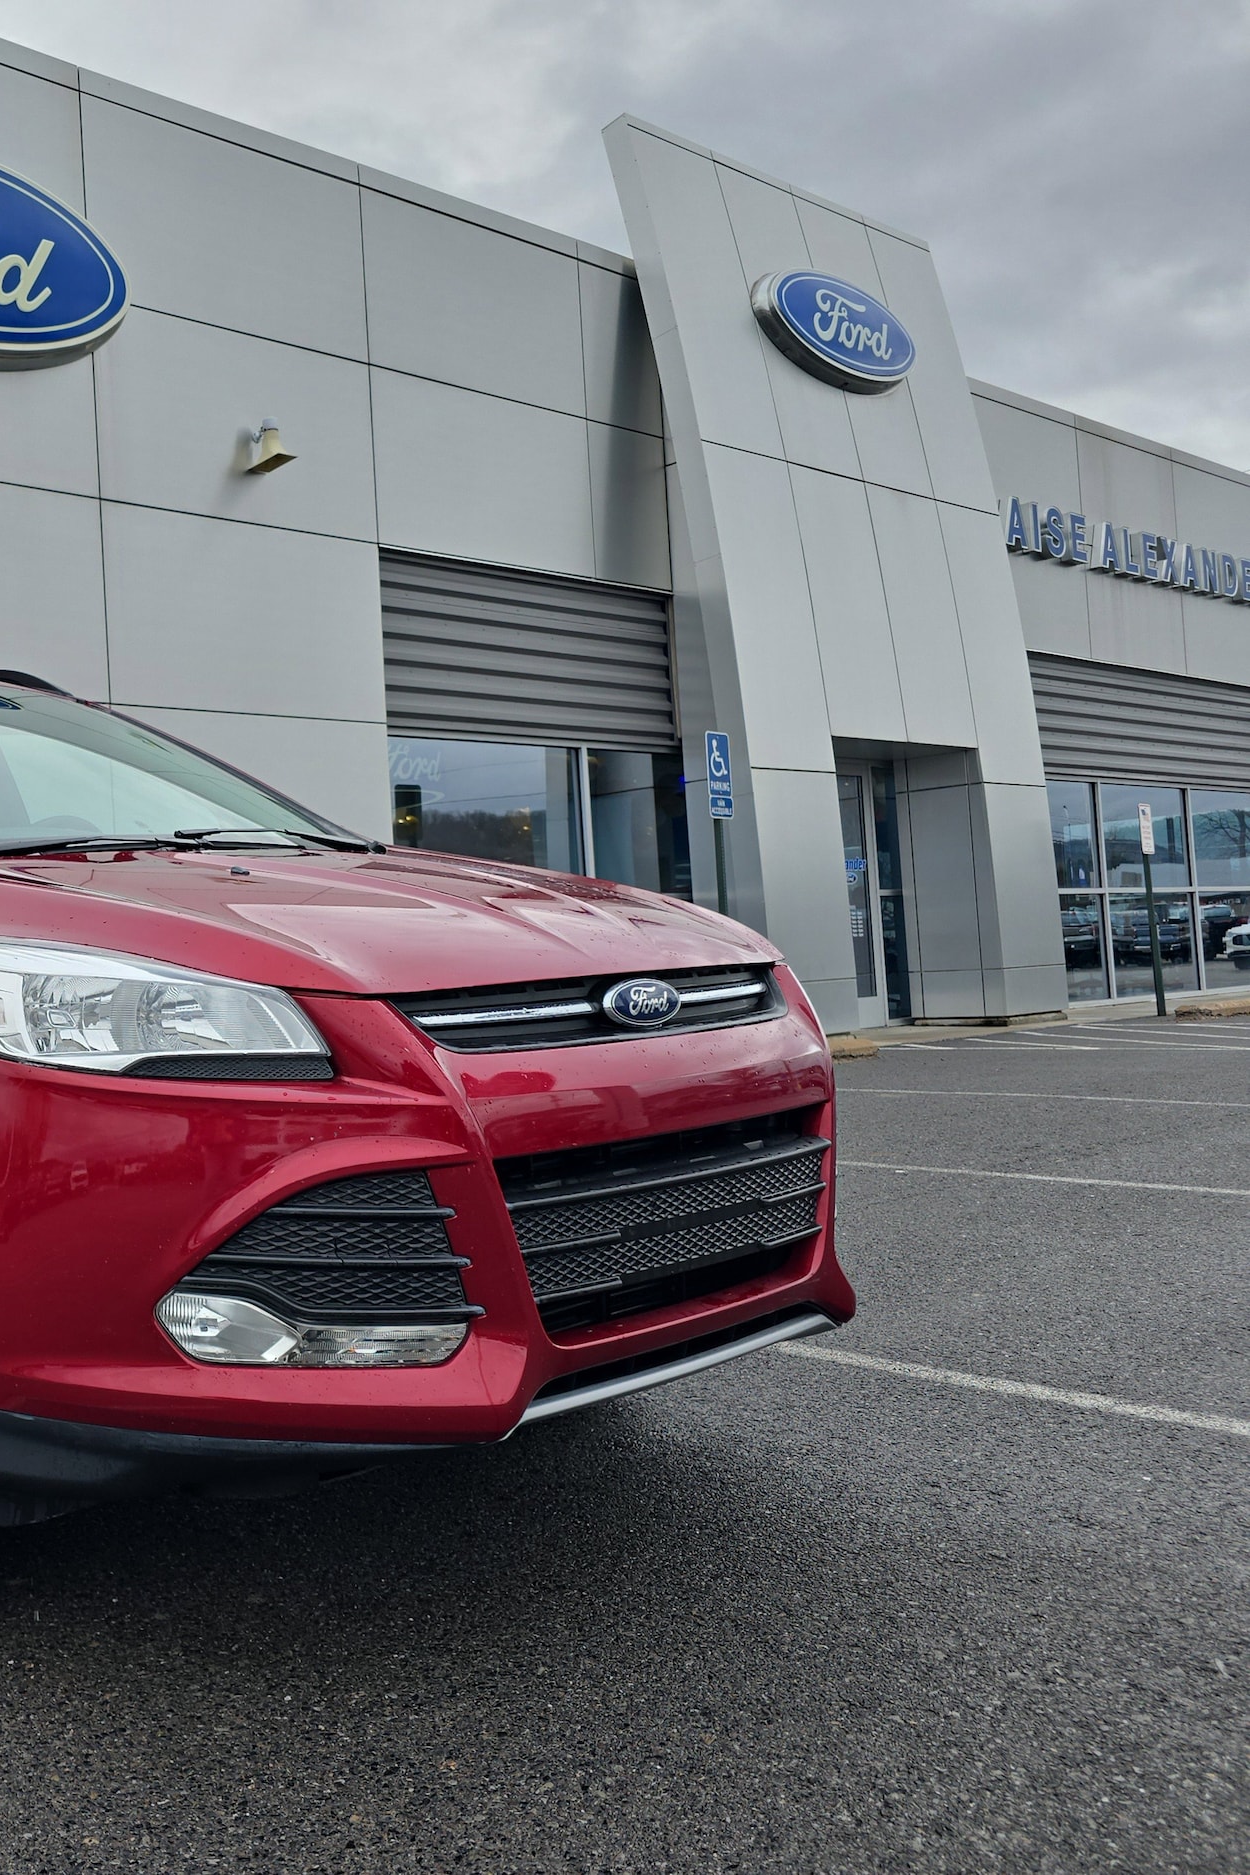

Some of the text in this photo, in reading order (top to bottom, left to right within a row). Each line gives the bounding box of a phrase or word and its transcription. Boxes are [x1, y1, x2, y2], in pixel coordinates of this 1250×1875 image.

[813, 289, 892, 360] Ford
[1006, 496, 1089, 564] AISE
[710, 780, 730, 792] PARKING
[629, 986, 669, 1016] Ford
